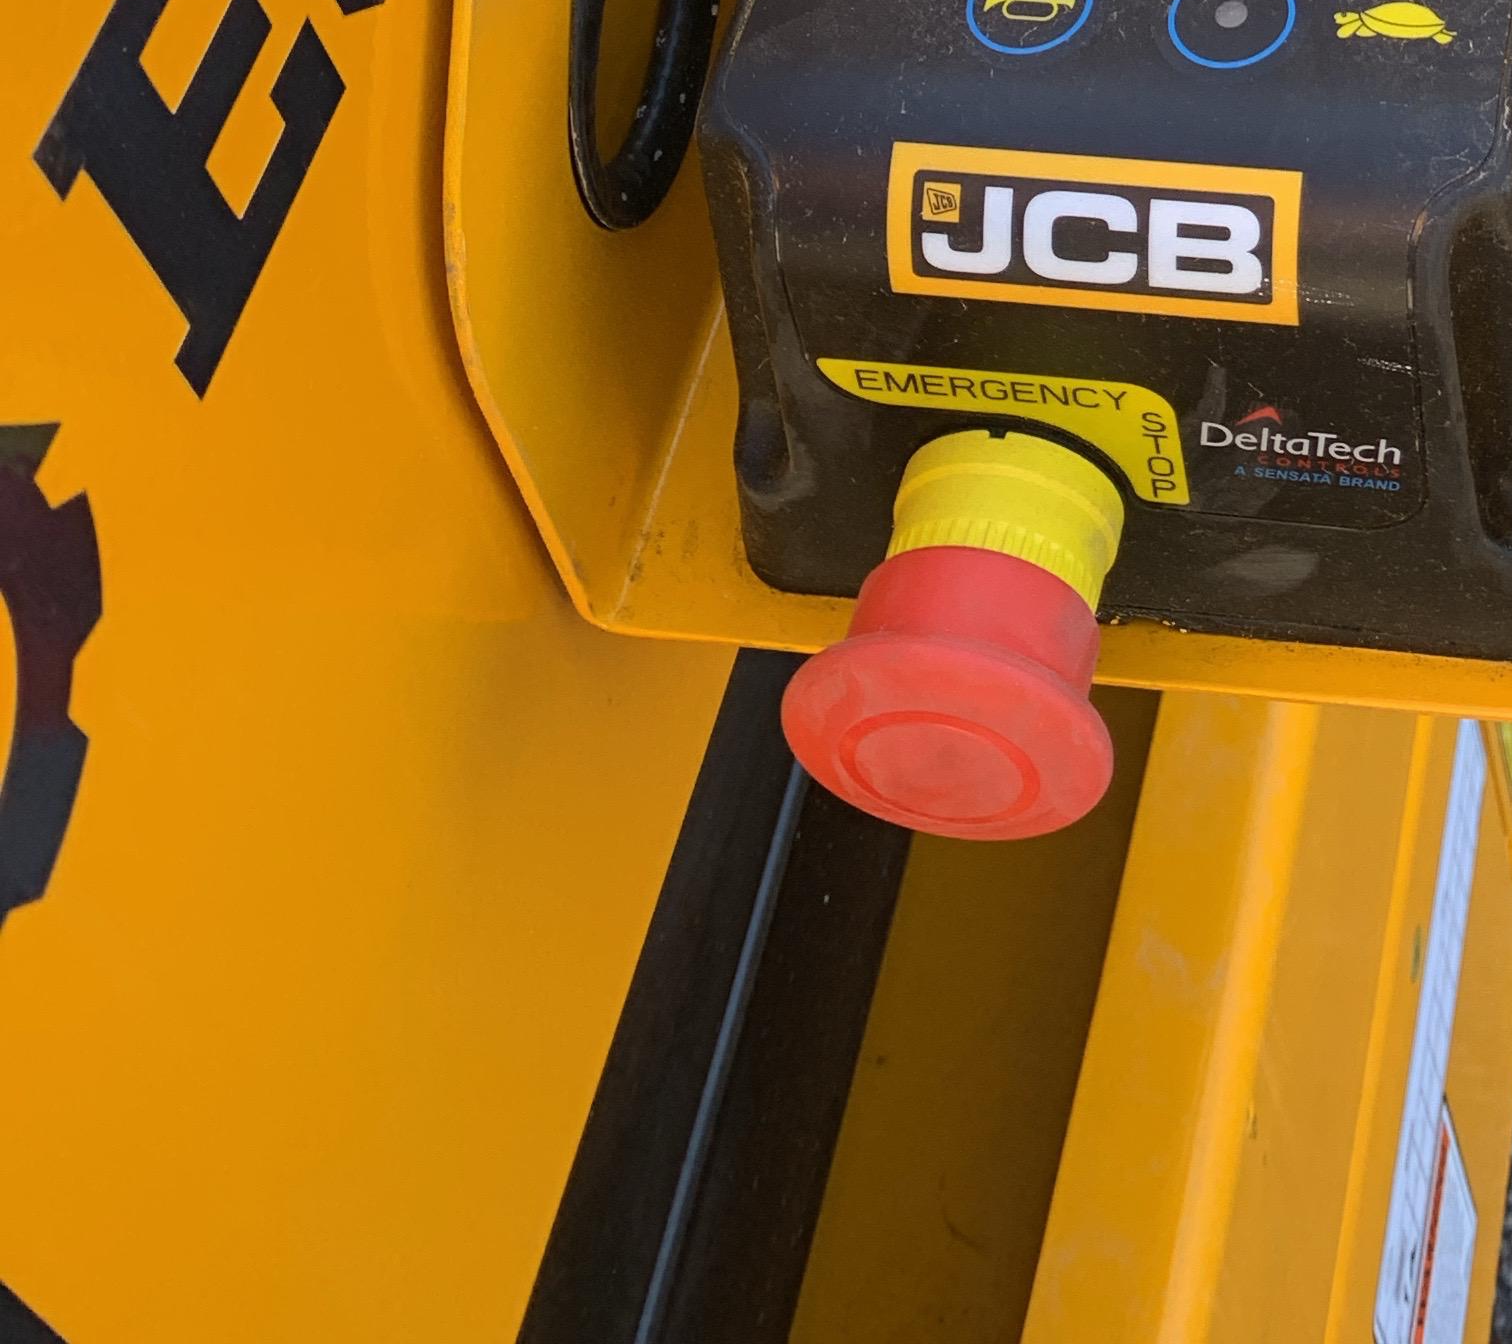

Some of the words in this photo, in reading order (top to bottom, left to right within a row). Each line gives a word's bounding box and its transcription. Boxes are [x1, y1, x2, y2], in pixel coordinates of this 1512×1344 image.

[930, 192, 956, 213] JCB
[920, 185, 1264, 295] JCB
[854, 368, 1128, 411] EMERGENCY
[1141, 411, 1177, 499] STOP
[1199, 420, 1402, 466] DeltaTech
[1233, 464, 1247, 477] A
[1253, 466, 1332, 486] SENSATA
[1338, 475, 1401, 492] BRAND
[1256, 453, 1401, 479] CONTROLS
